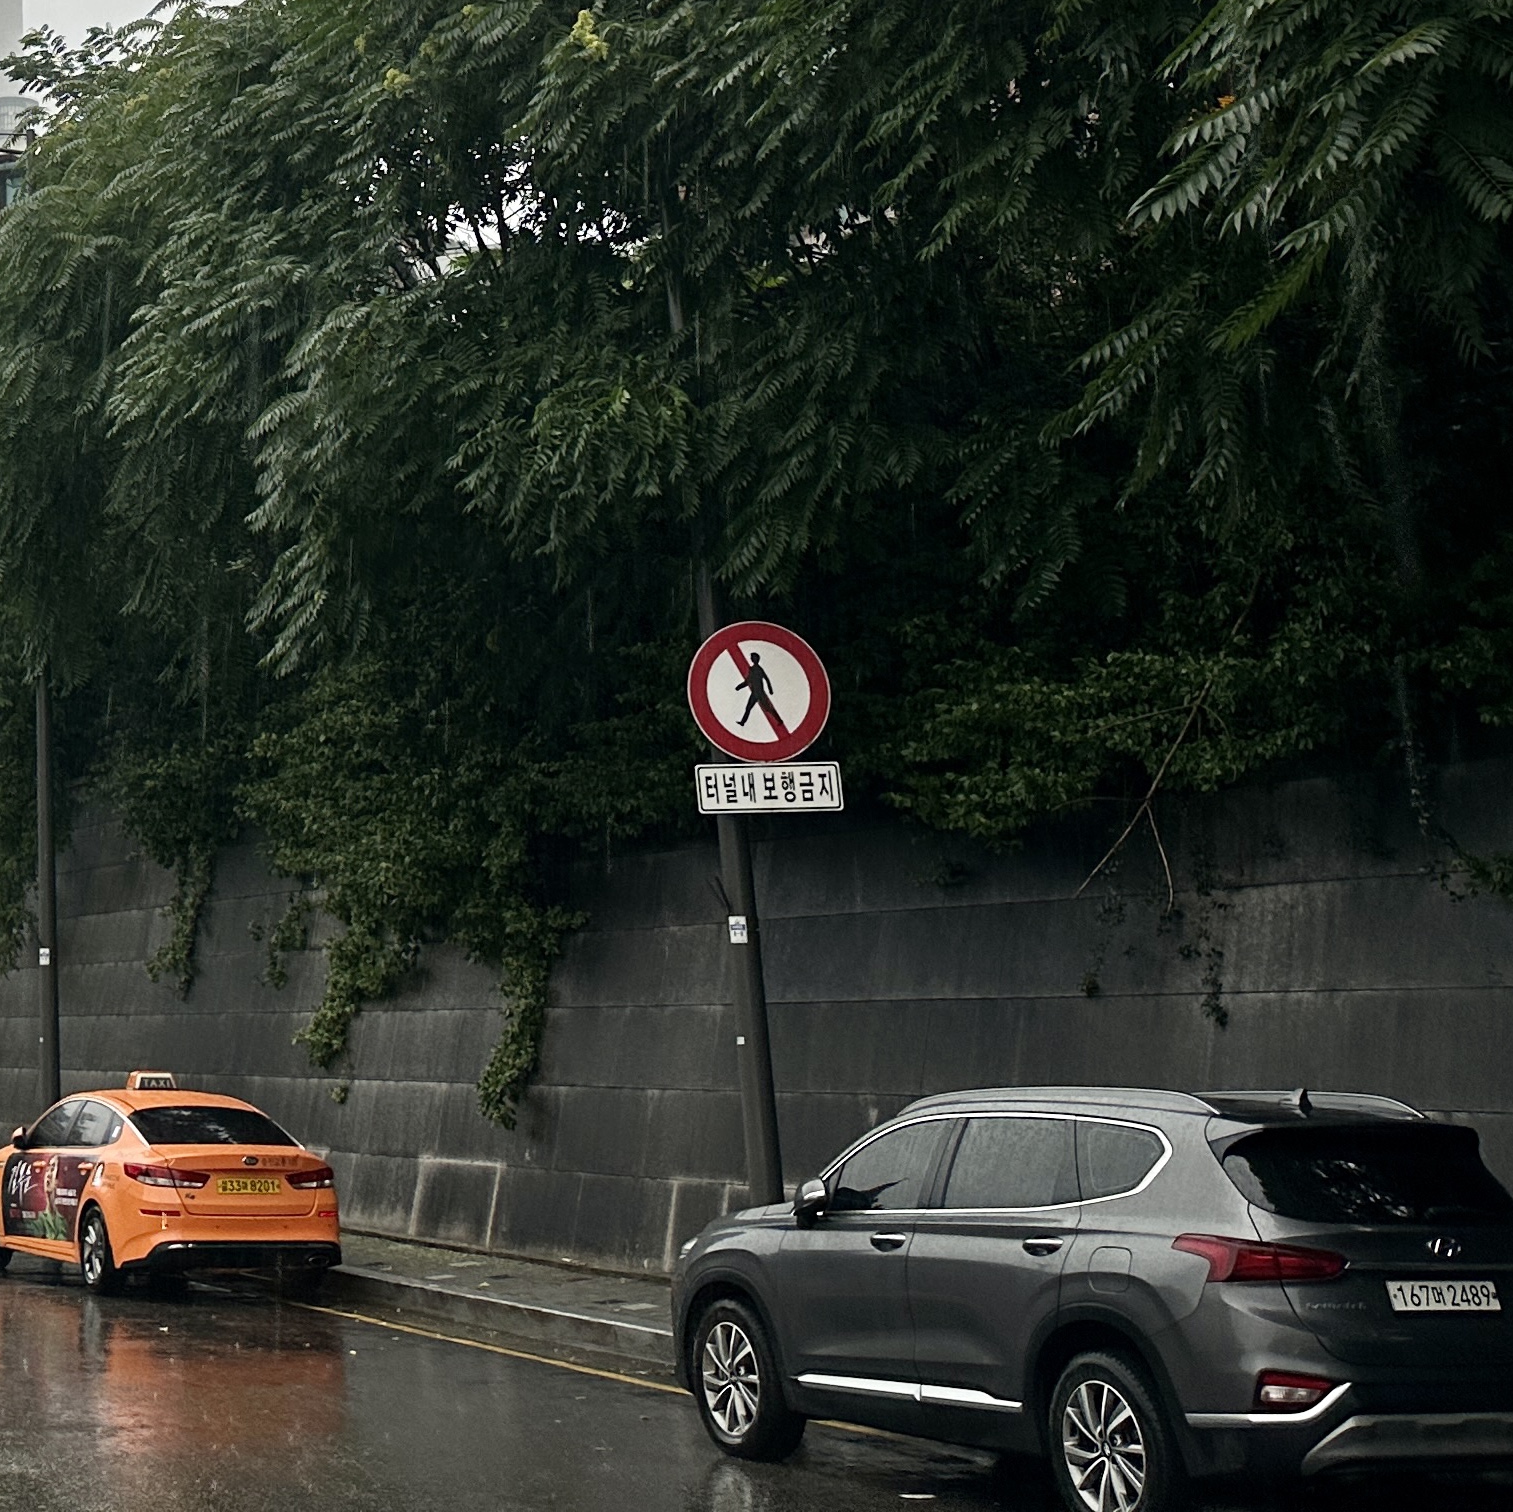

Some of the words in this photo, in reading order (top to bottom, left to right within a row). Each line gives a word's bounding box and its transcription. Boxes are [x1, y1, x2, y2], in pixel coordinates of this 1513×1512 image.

[704, 772, 756, 804] 터널내
[763, 771, 834, 803] 보행금지
[143, 1079, 171, 1088] TAXI
